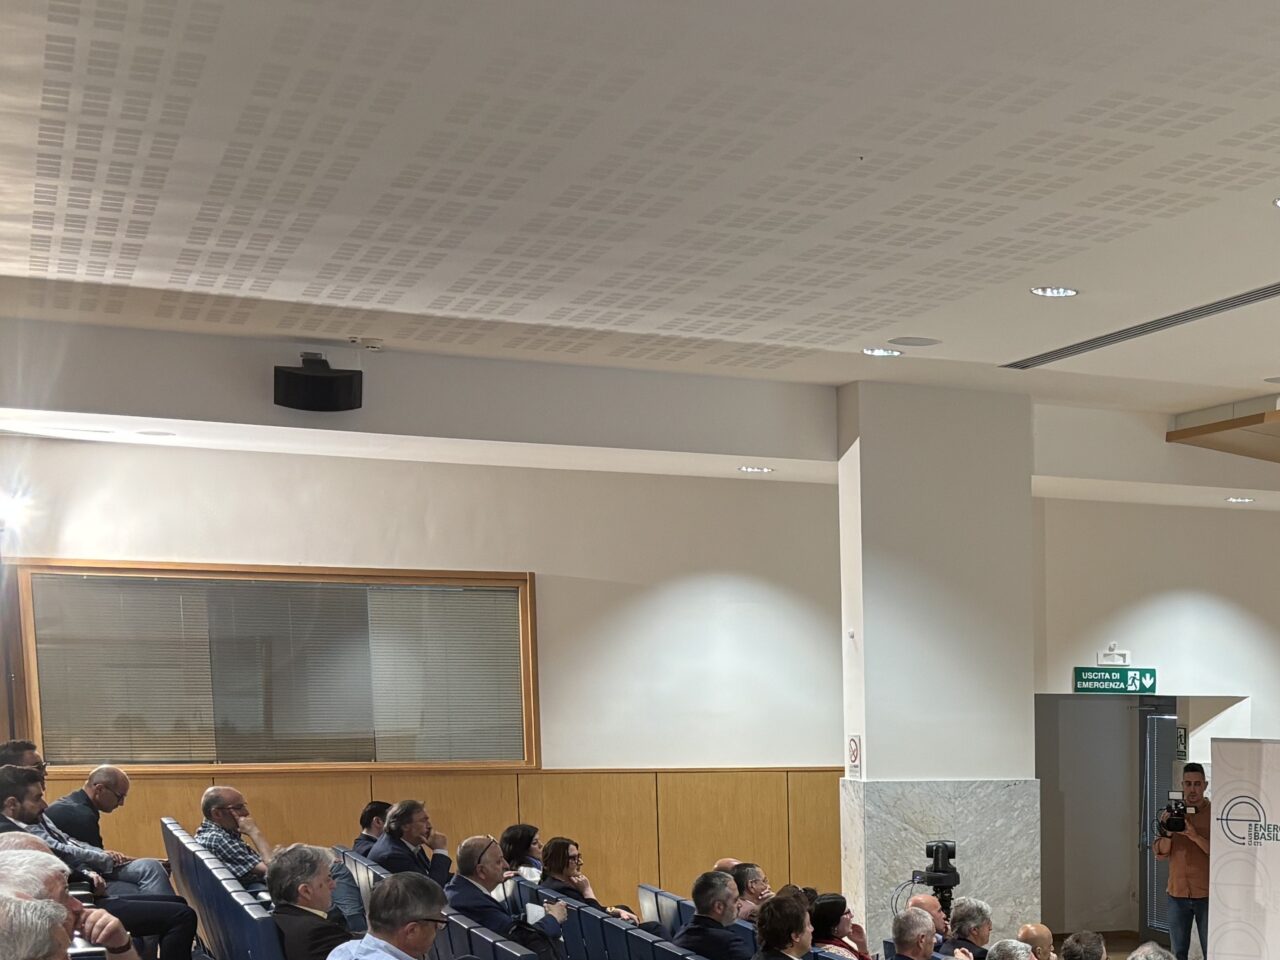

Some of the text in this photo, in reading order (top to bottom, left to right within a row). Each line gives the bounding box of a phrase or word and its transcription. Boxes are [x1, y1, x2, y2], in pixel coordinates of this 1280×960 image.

[1082, 672, 1120, 680] USCITA DI
[1077, 681, 1125, 689] EMERGENZA
